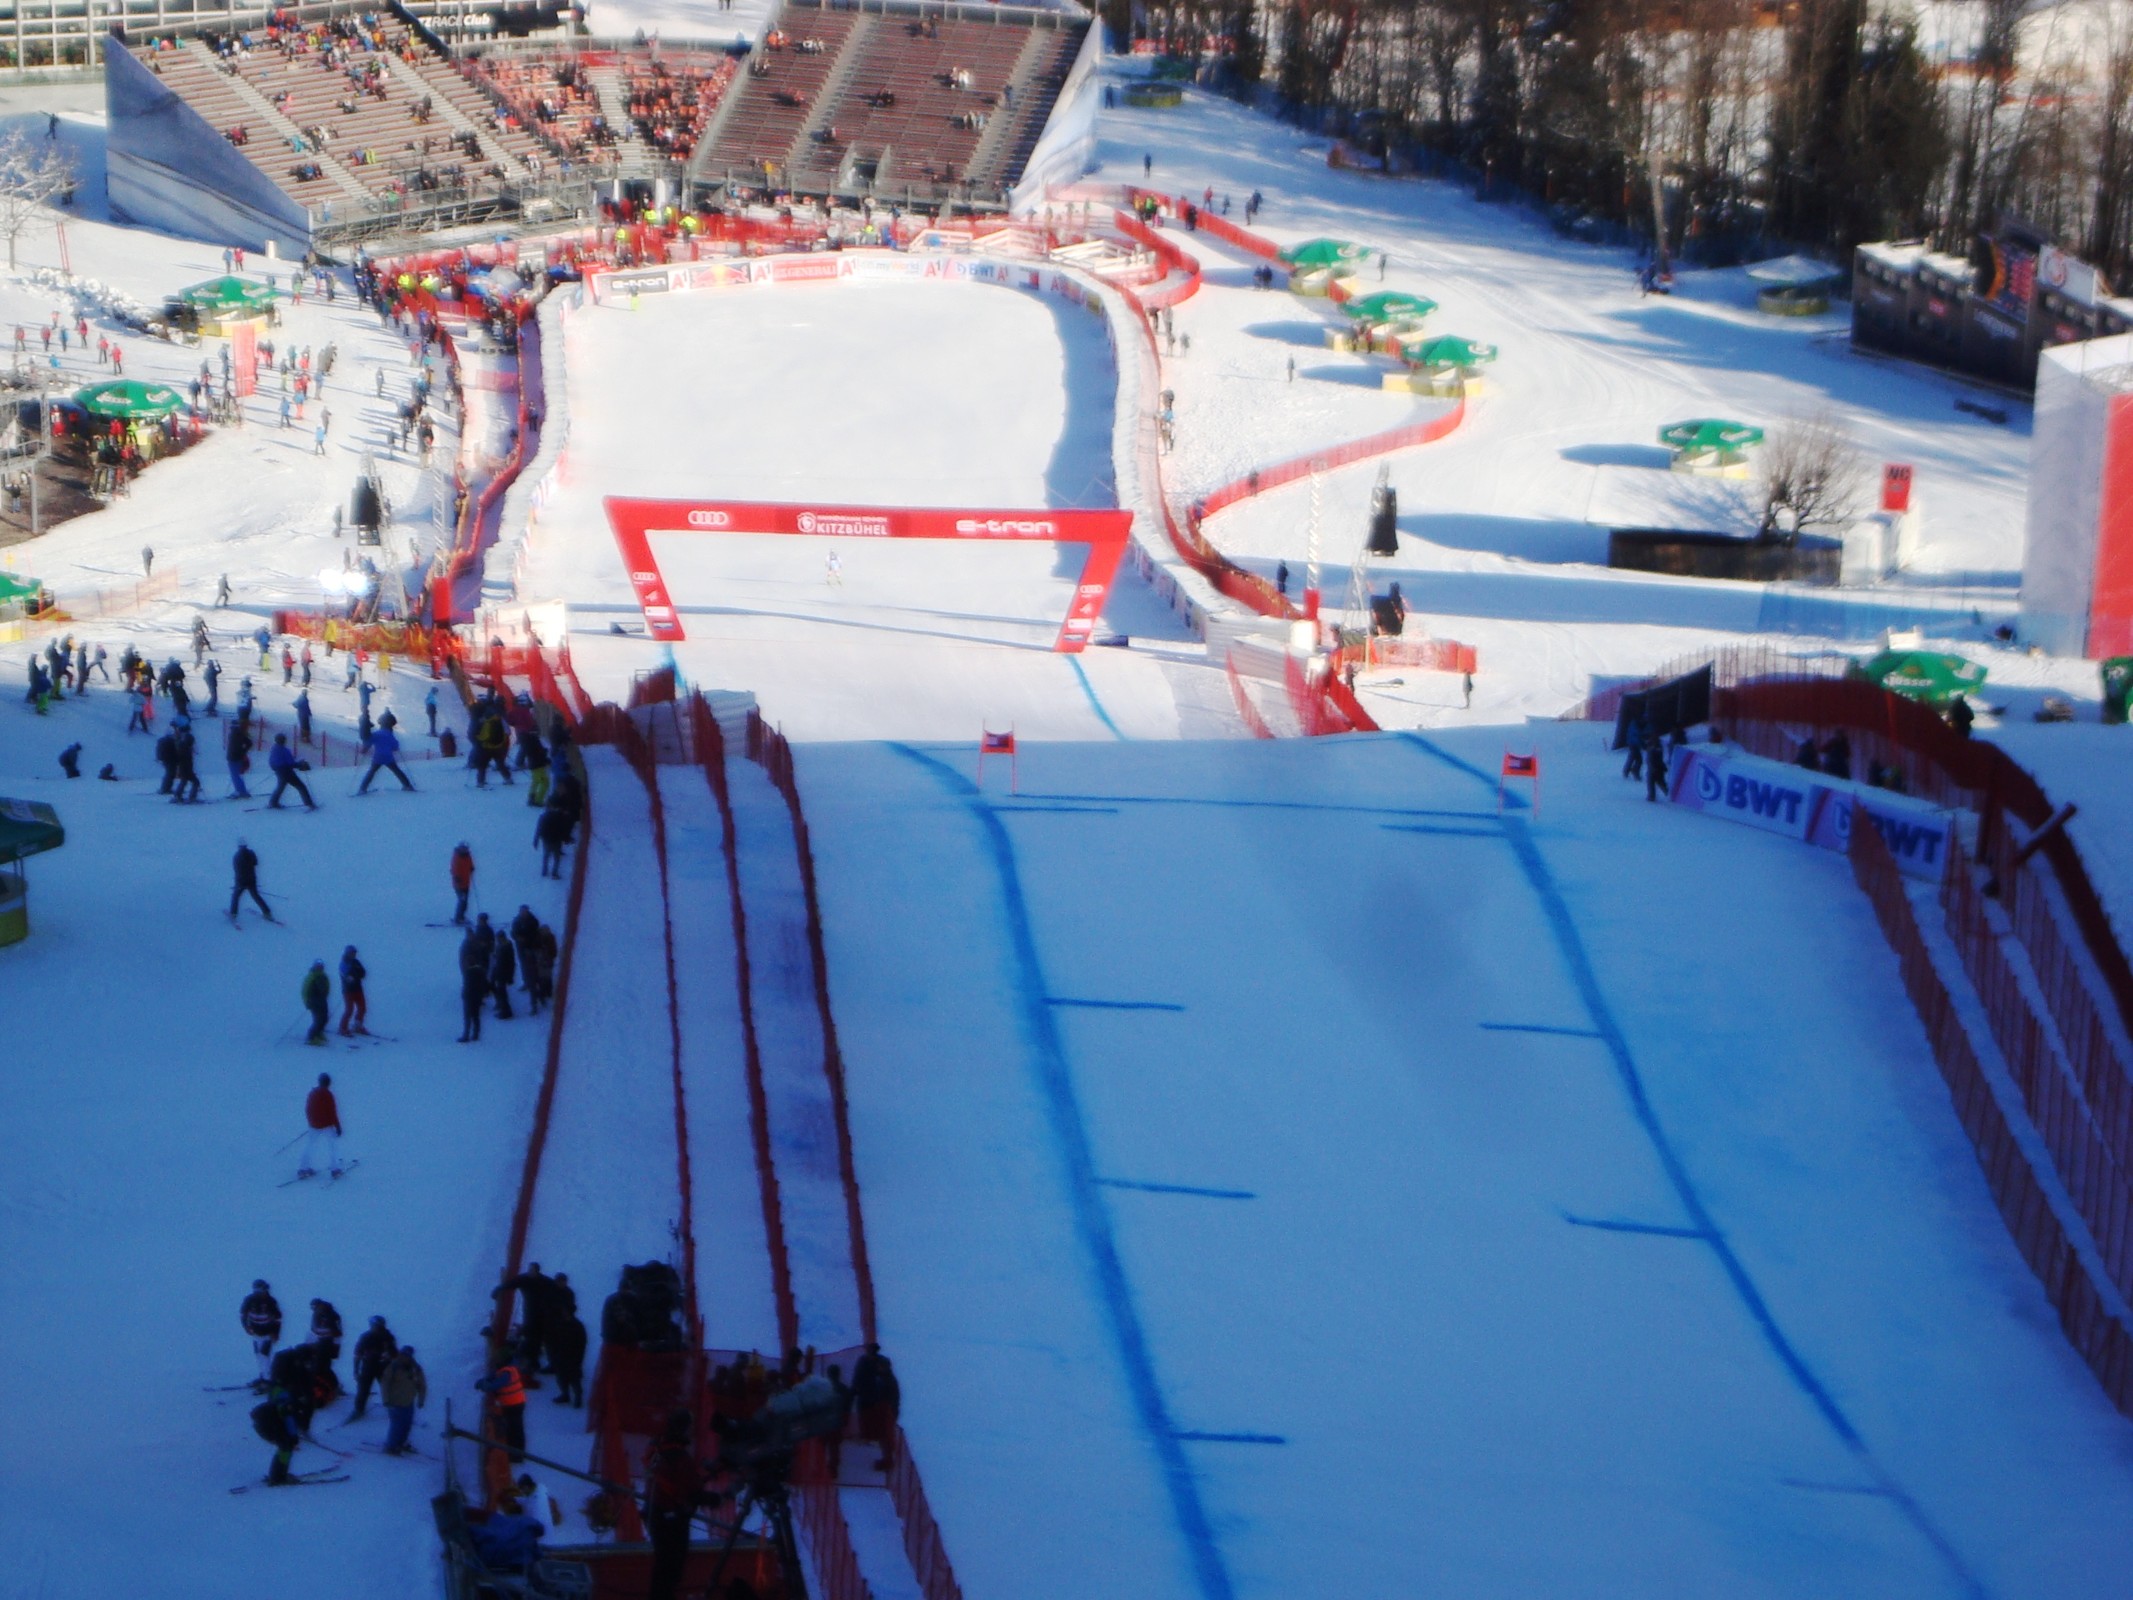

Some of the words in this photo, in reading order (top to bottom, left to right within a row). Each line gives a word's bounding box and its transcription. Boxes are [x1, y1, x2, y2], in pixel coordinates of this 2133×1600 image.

[463, 13, 491, 27] Club
[924, 259, 941, 278] A1
[817, 522, 887, 536] KITZBÜHEL
[956, 519, 1054, 534] e-tron
[1725, 772, 1804, 824] BWT
